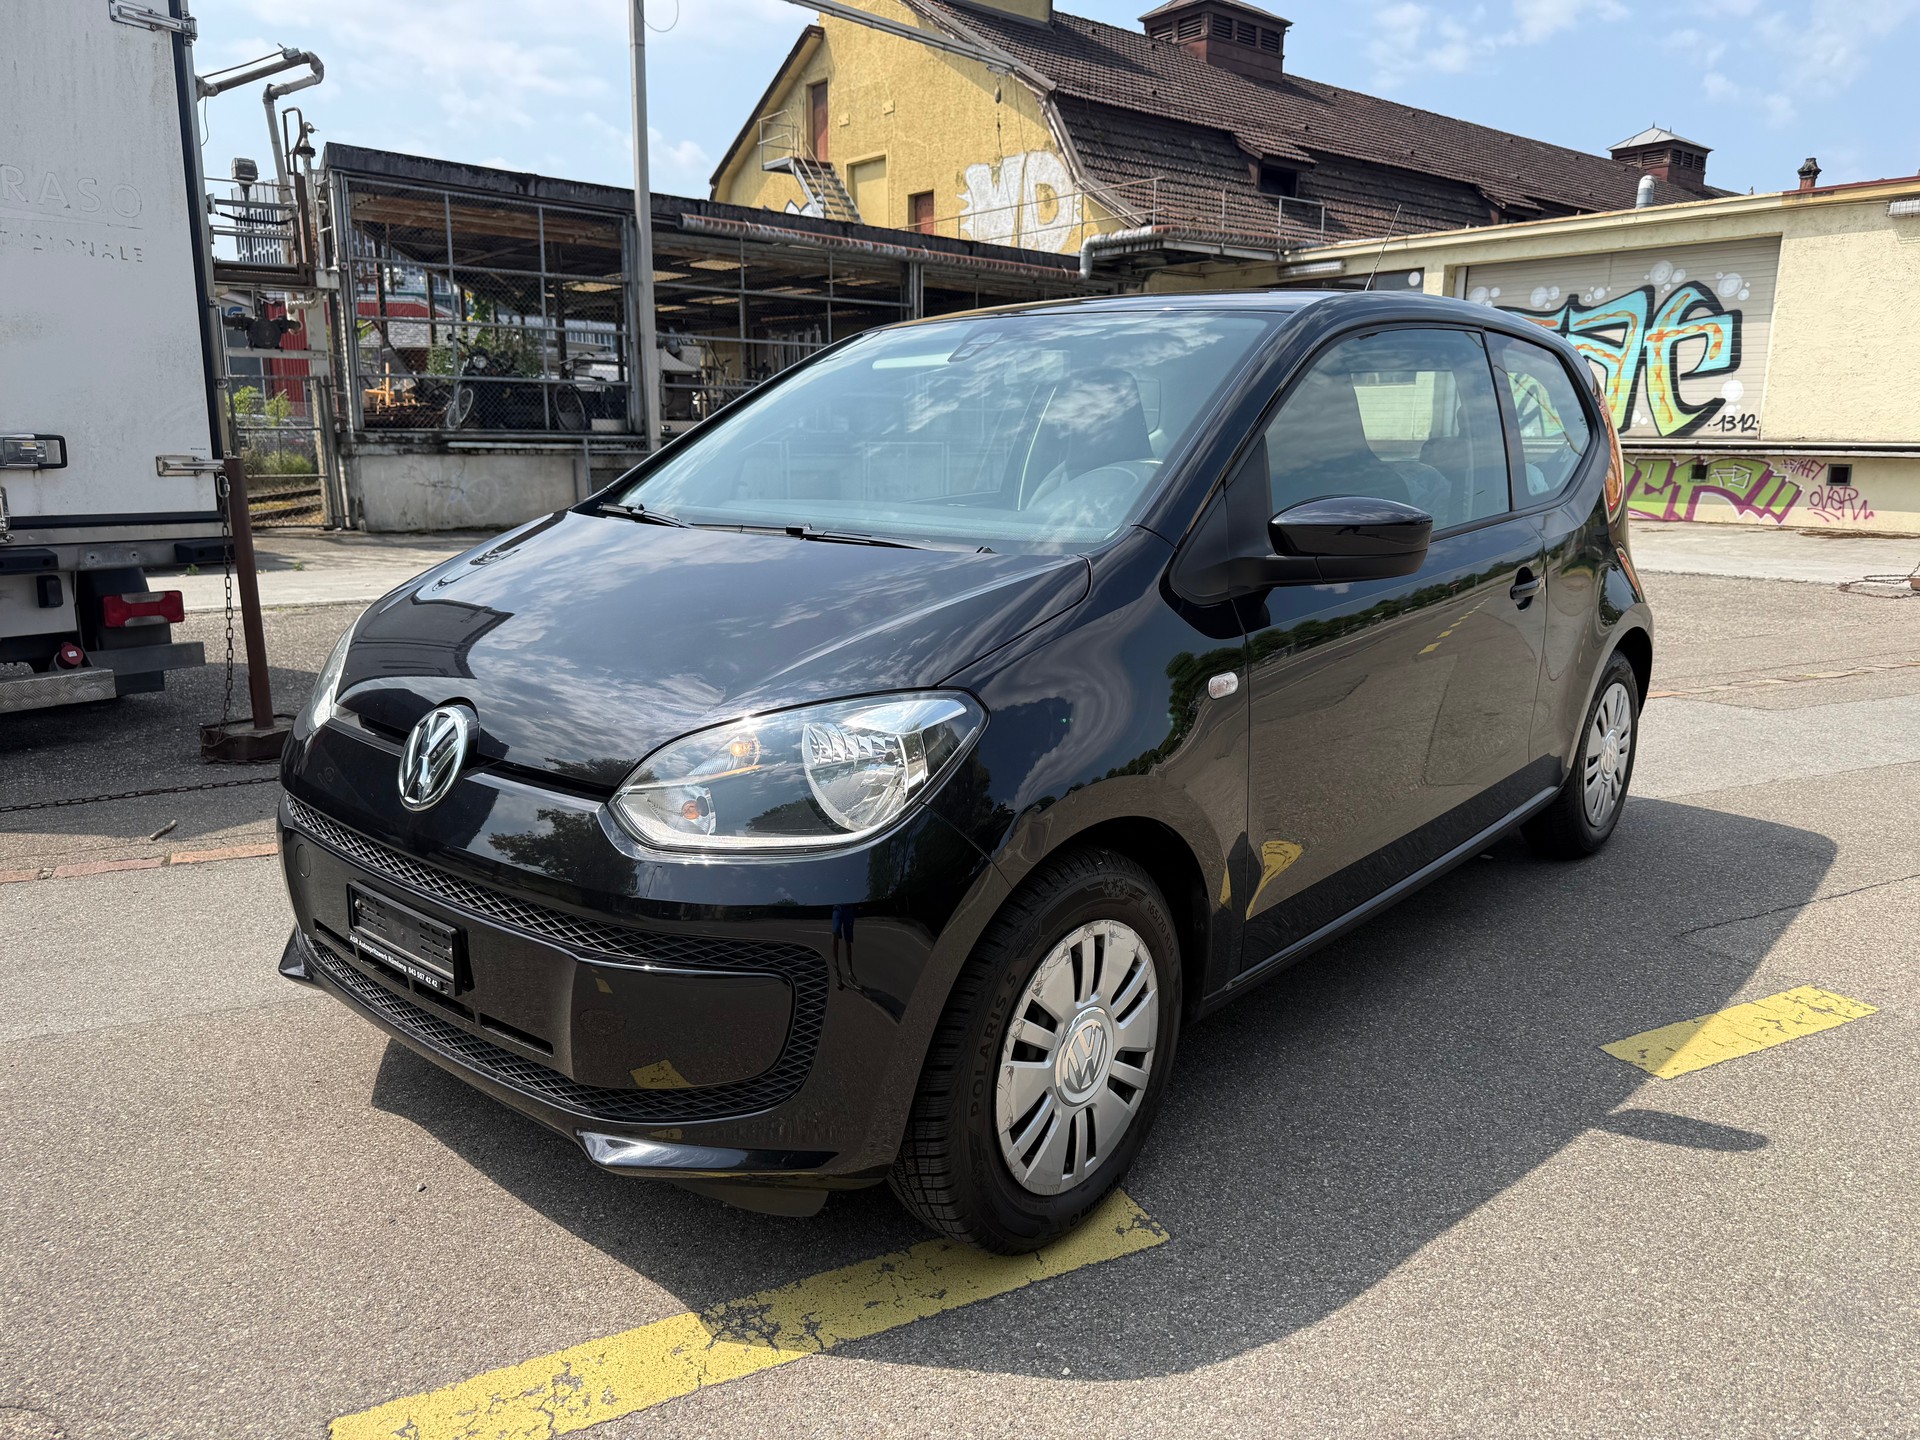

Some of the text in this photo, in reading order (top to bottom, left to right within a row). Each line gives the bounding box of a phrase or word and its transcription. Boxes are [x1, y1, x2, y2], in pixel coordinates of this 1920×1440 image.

[1147, 901, 1167, 934] 165/70
[970, 971, 1017, 1118] POLARIS 5
